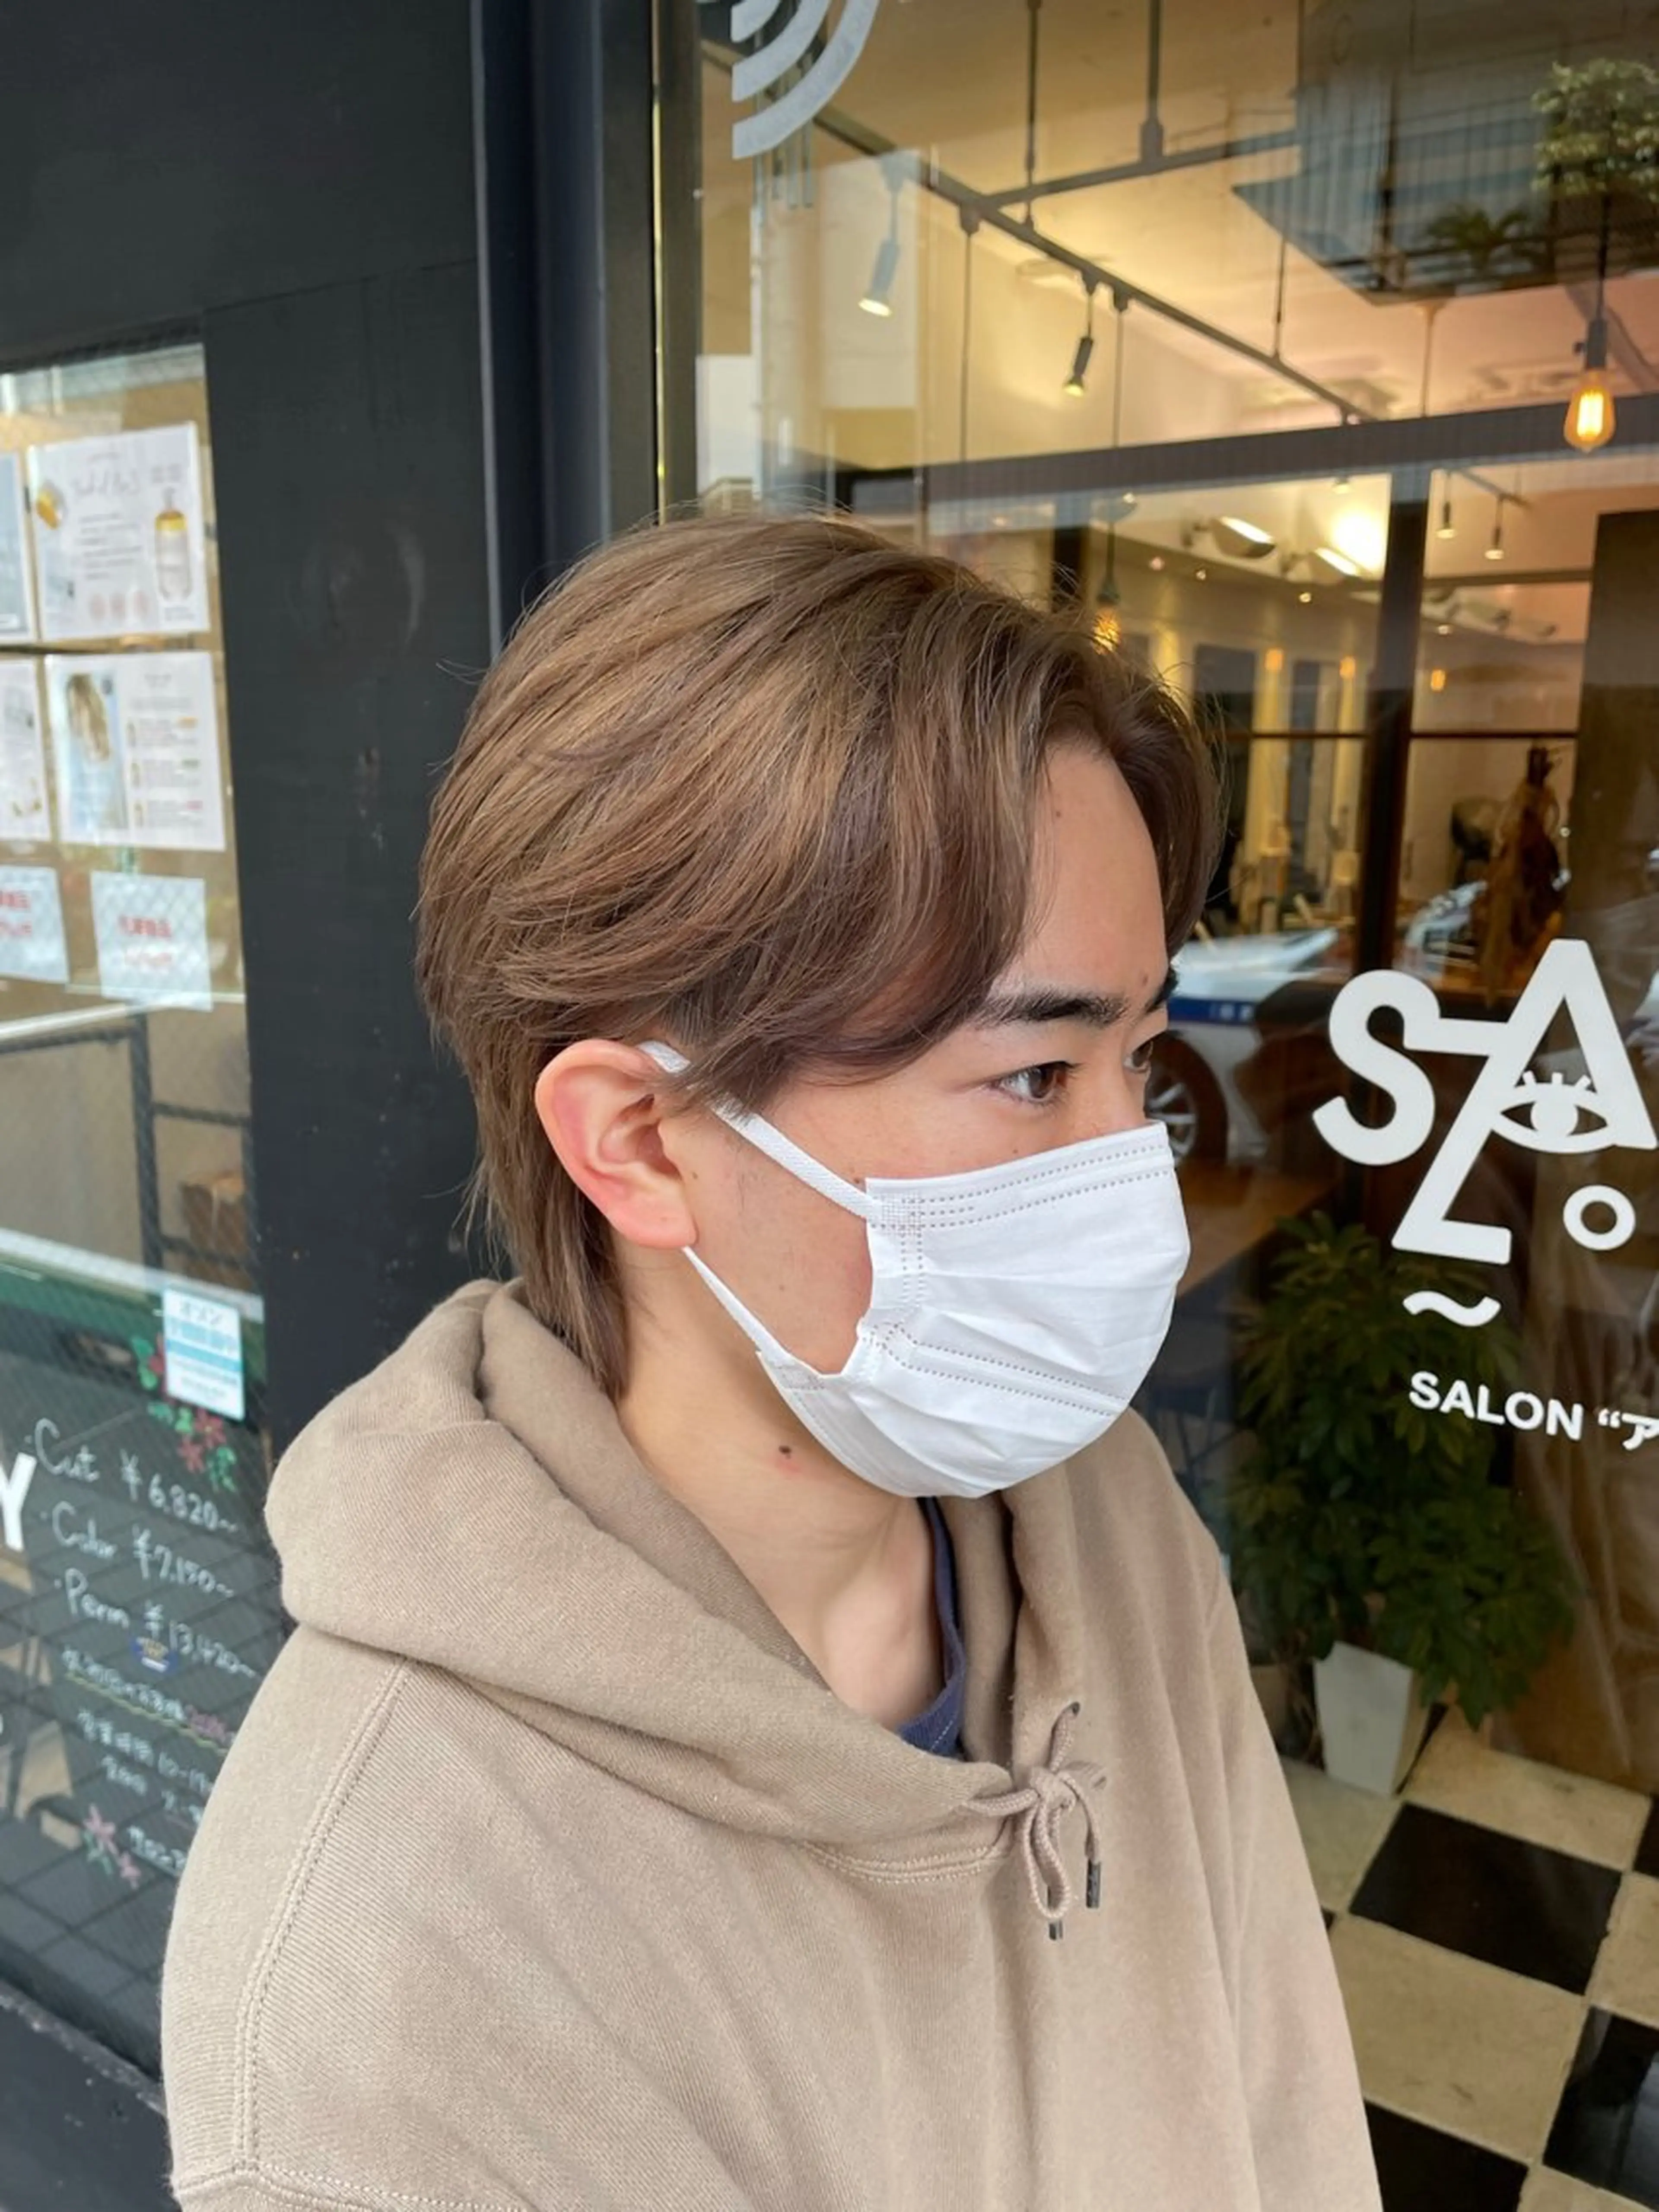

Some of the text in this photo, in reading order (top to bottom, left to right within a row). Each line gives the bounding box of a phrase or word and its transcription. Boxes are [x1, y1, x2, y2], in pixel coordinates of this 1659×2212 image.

[1408, 1370, 1584, 1441] SALON
[35, 1417, 101, 1483] Cut
[65, 1567, 130, 1629] Perm
